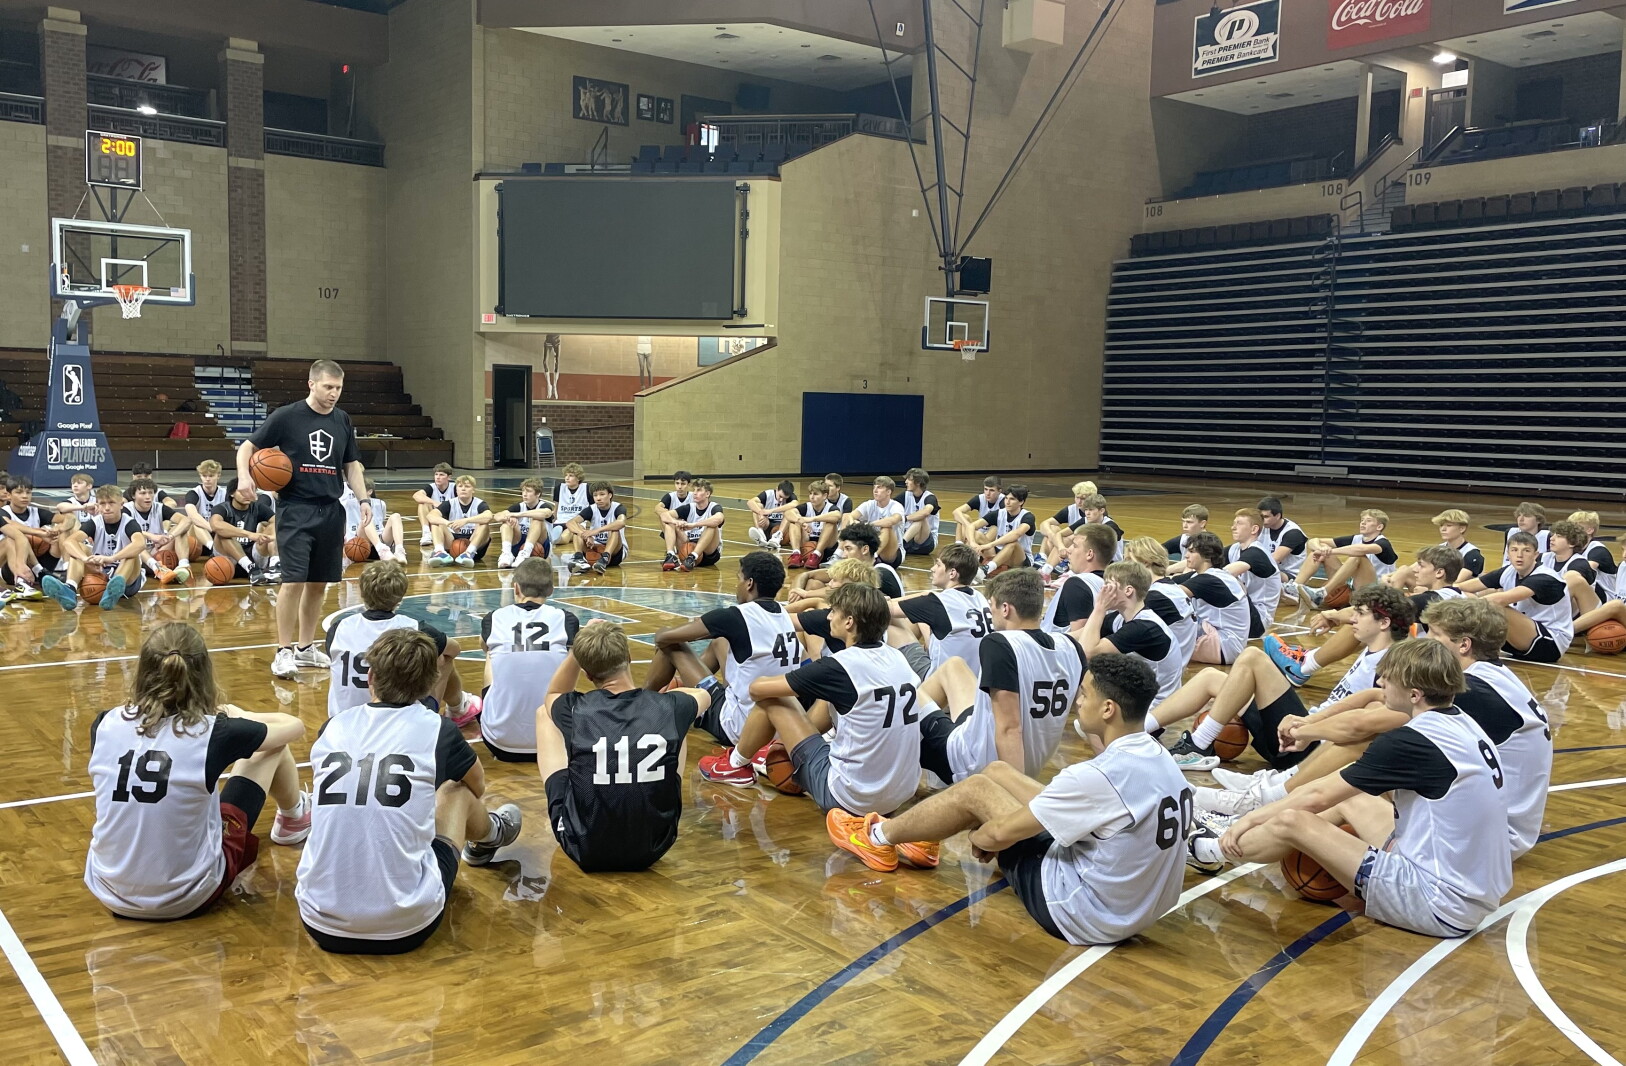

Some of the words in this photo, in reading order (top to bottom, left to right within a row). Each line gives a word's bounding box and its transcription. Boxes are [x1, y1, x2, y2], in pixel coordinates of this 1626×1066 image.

[1202, 48, 1219, 57] First
[1218, 40, 1252, 53] PREMIER
[1253, 37, 1271, 46] Bank
[1202, 54, 1235, 67] PREMIER
[1237, 47, 1269, 58] Bankcard
[101, 138, 136, 157] 2:00
[1409, 172, 1431, 186] 109
[1321, 183, 1343, 197] 108
[1146, 205, 1163, 218] 108
[318, 287, 339, 299] 107
[862, 379, 868, 390] 3
[57, 422, 79, 430] Google
[61, 446, 106, 463] PLAYOFFS
[511, 621, 550, 652] 12
[772, 631, 800, 667] 47
[874, 682, 919, 729] 72
[1030, 679, 1069, 719] 56
[592, 733, 668, 785] 112
[1477, 738, 1503, 790] 9
[111, 750, 173, 804] 19
[317, 751, 415, 808] 216
[1156, 787, 1193, 850] 60
